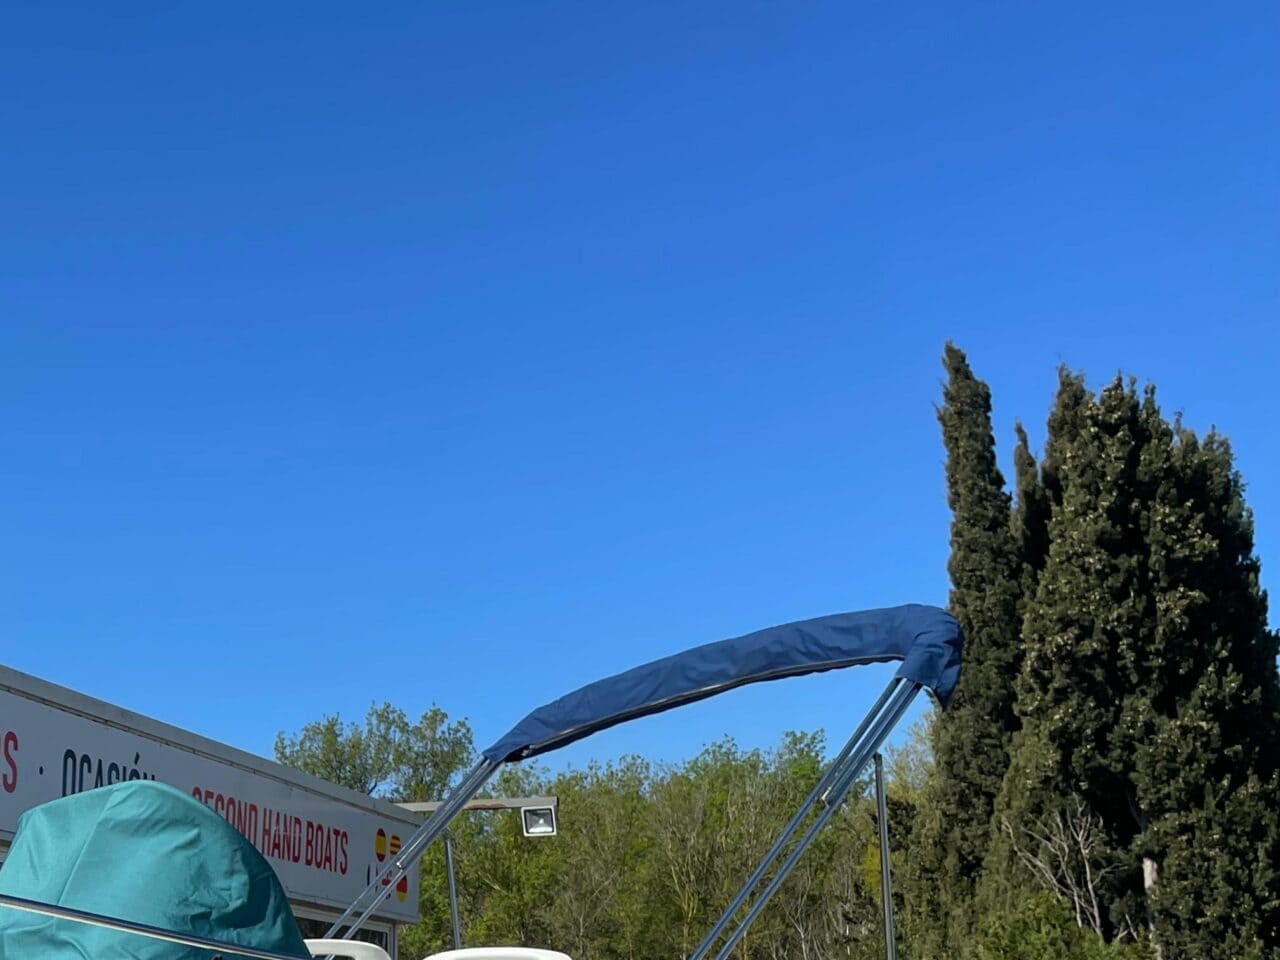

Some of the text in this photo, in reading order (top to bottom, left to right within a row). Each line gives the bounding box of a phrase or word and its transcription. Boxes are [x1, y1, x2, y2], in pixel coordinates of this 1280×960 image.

[192, 786, 258, 848] OND
[263, 807, 302, 864] HAND
[305, 821, 349, 876] BOATS
